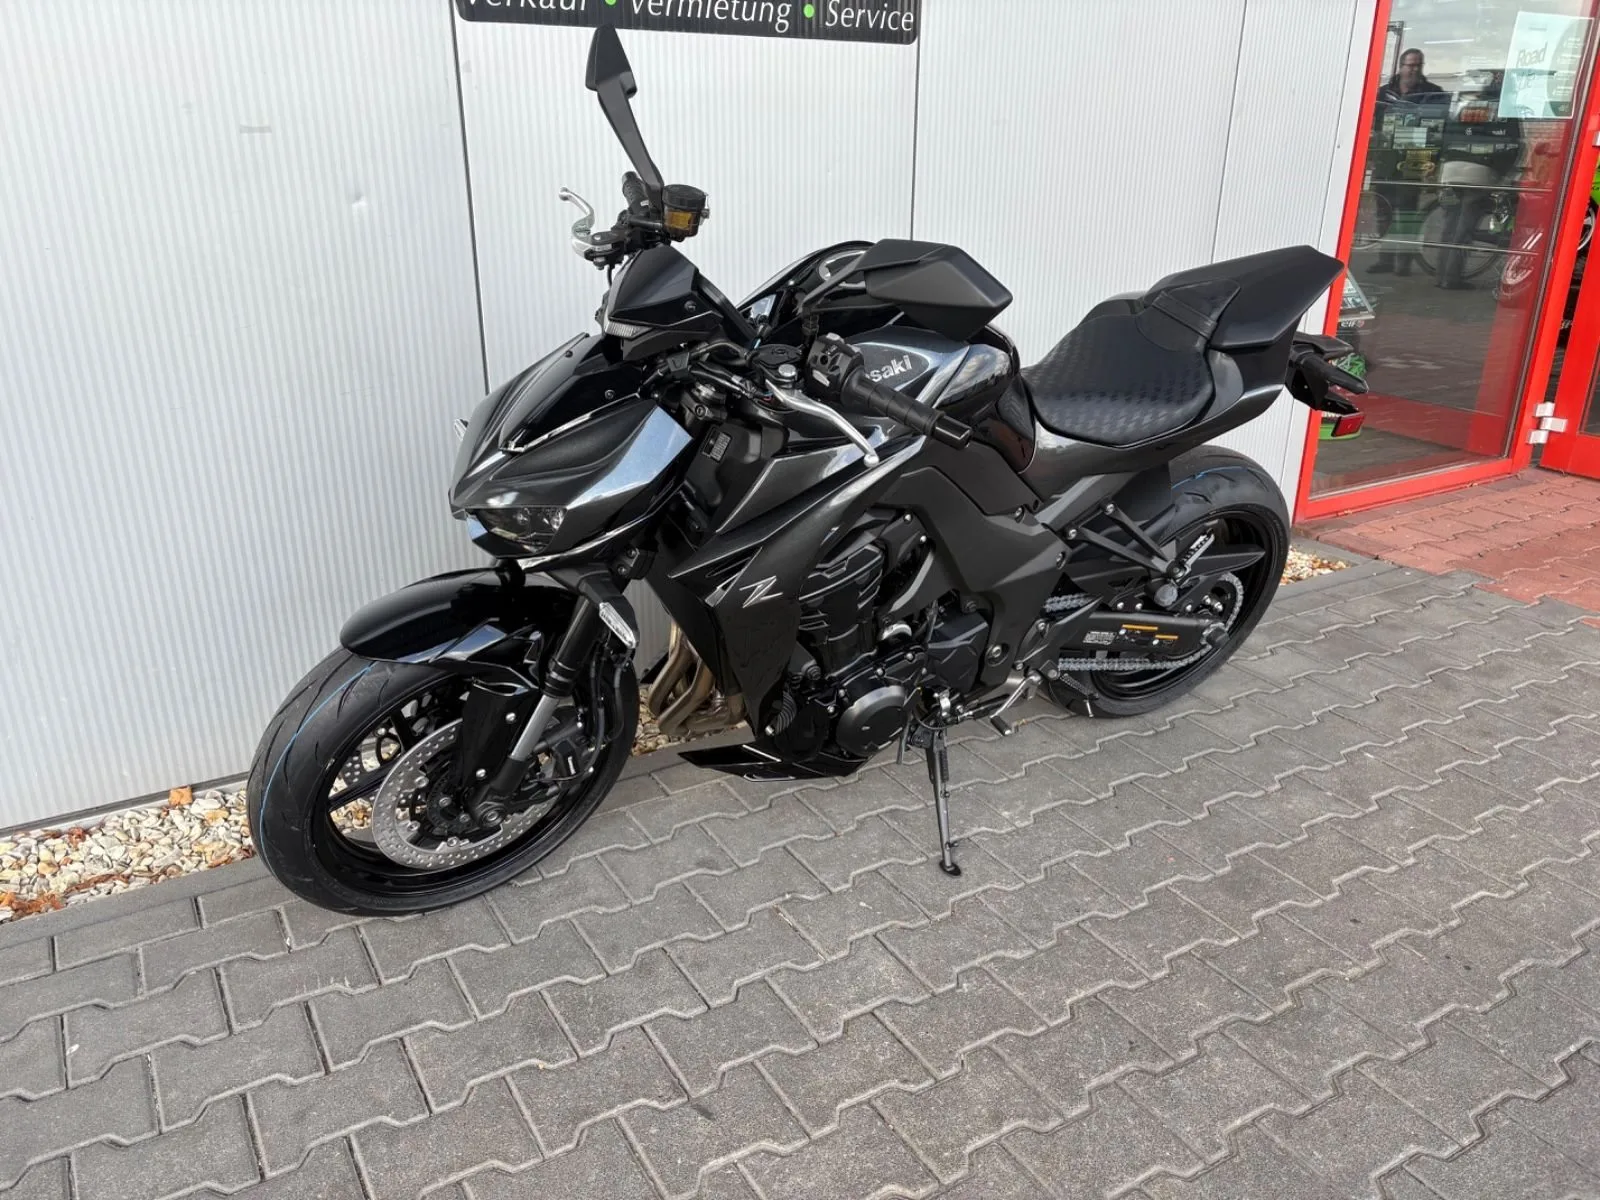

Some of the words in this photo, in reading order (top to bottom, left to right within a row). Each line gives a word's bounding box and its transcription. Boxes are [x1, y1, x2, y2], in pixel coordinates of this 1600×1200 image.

[631, 0, 793, 34] Vermietung
[824, 0, 914, 31] Service
[865, 354, 912, 383] saki
